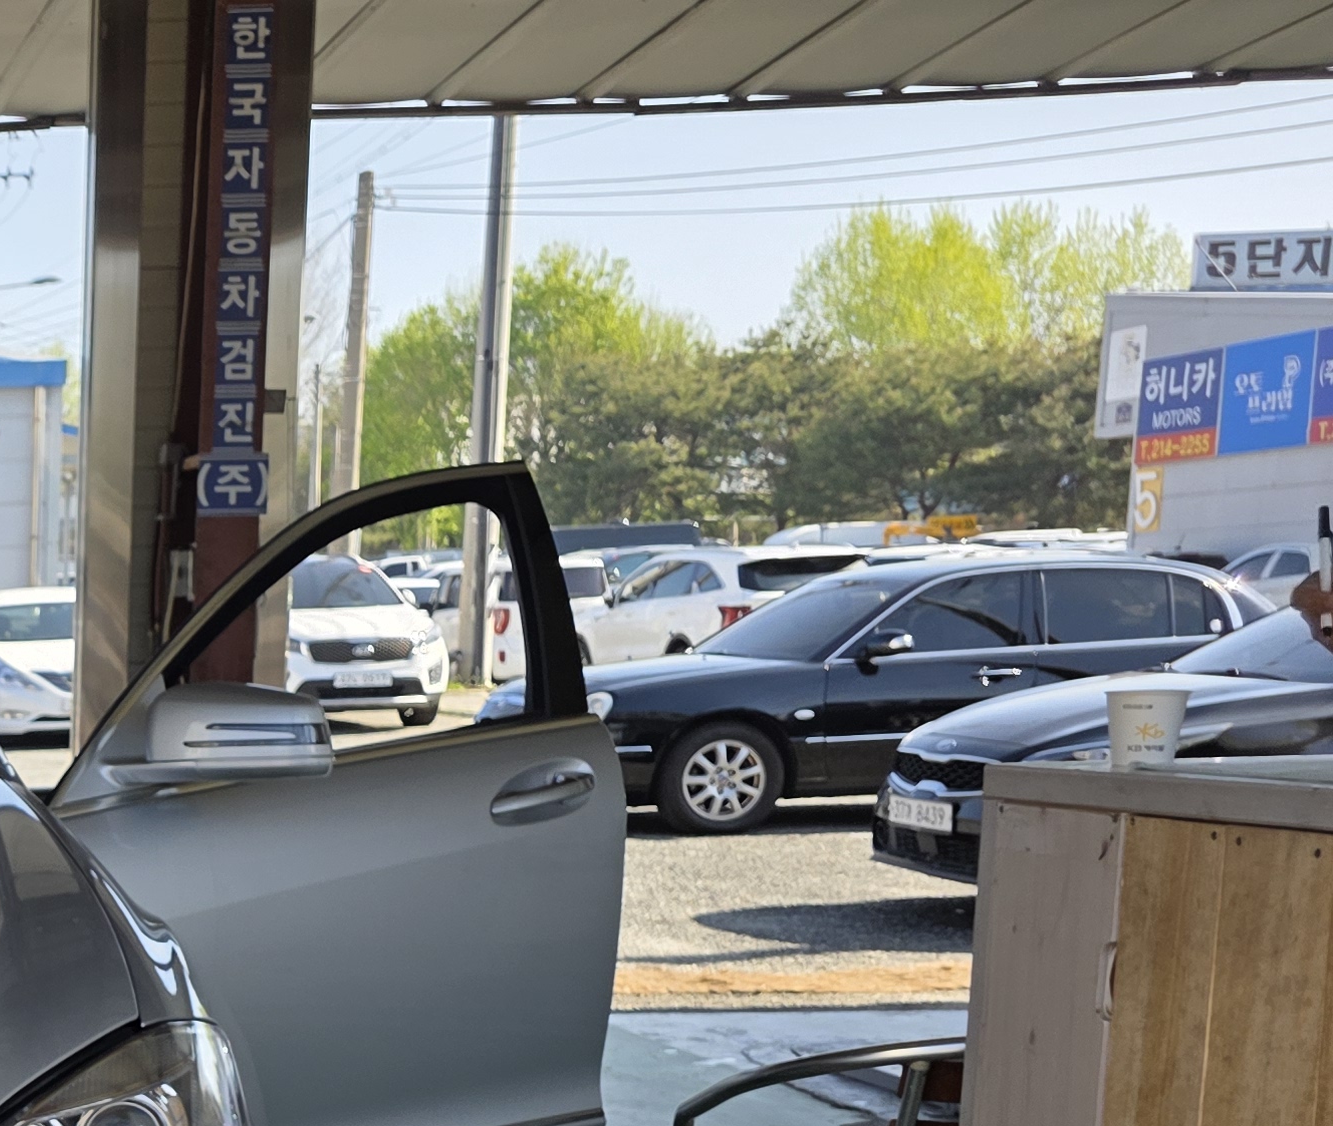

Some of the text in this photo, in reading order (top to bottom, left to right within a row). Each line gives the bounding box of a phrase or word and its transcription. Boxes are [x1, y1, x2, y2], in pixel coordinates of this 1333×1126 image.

[1205, 235, 1332, 279] 5단지
[1145, 358, 1217, 405] 허니카
[1151, 406, 1202, 430] MOTORS
[1135, 471, 1157, 529] 5
